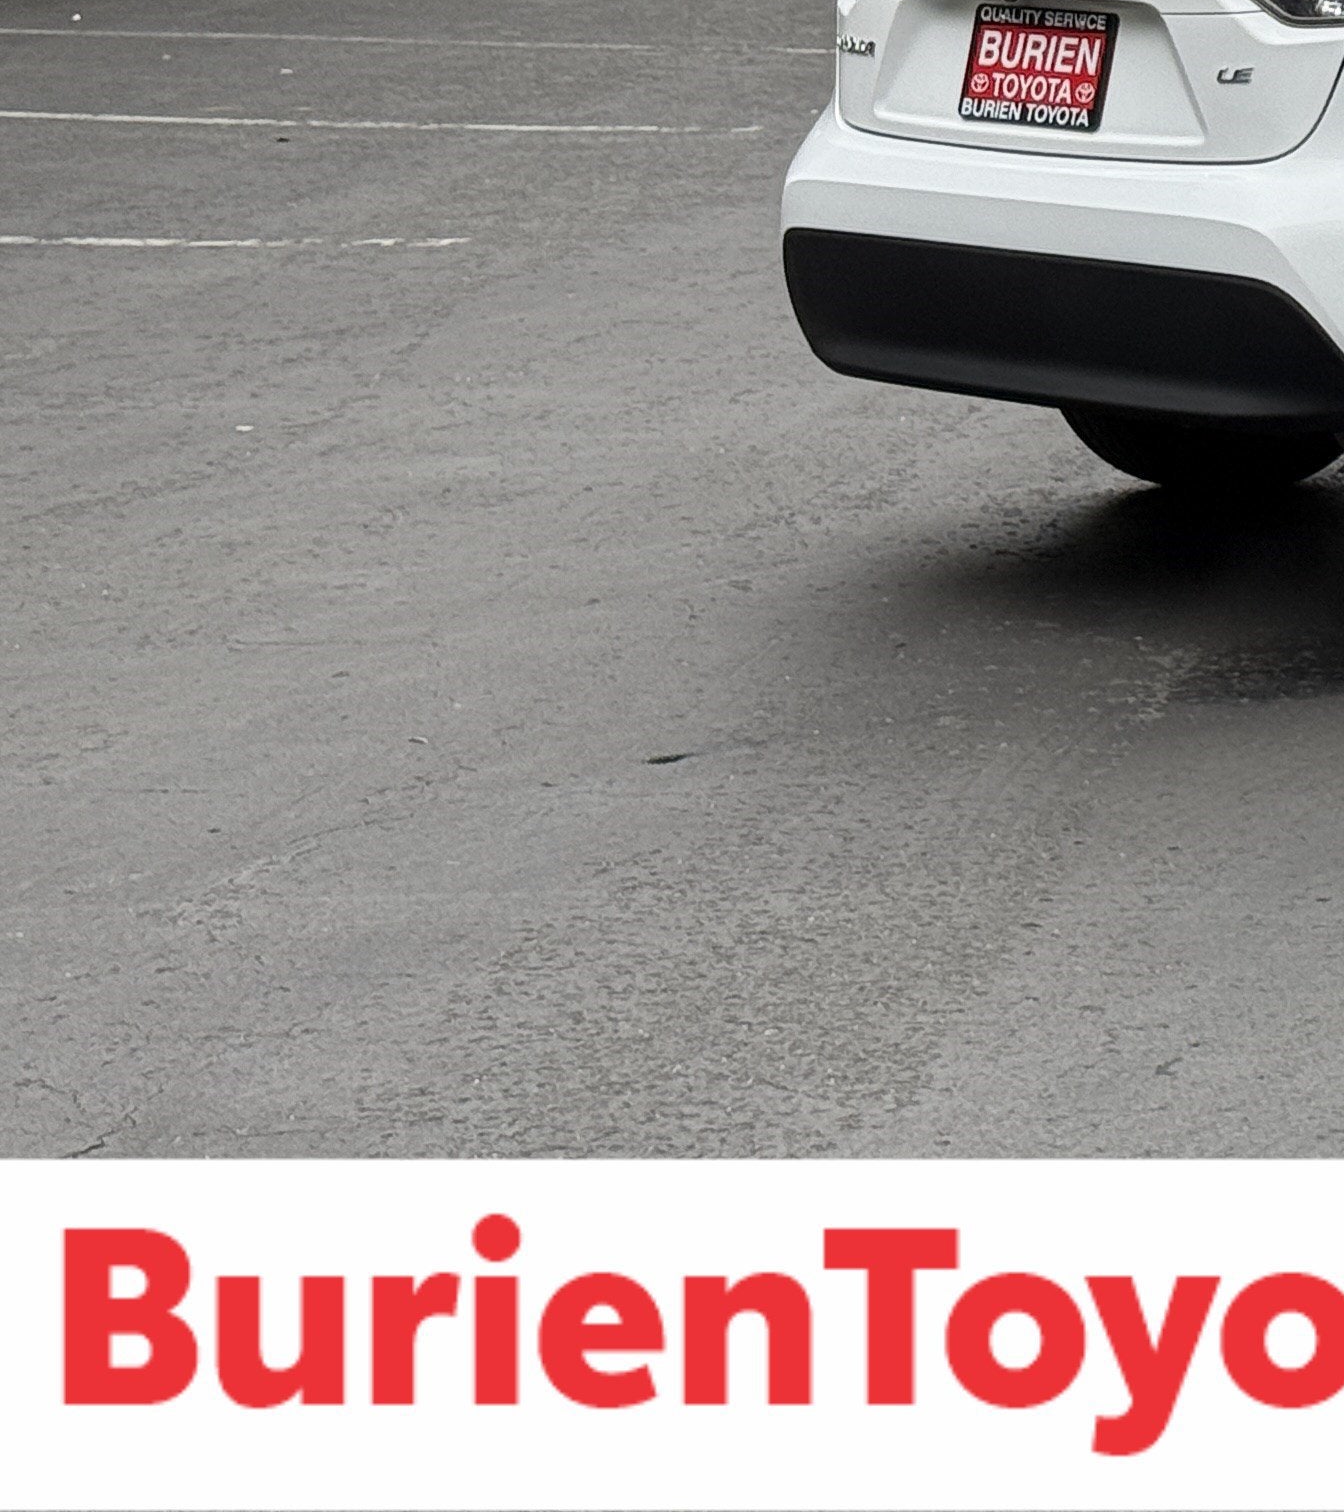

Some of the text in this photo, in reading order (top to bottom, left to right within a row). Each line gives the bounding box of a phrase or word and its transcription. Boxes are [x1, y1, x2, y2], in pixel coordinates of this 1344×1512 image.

[980, 6, 1108, 31] QUALITY SERVICE
[978, 29, 1102, 76] BURIEN
[991, 72, 1073, 104] TOYOTA
[1216, 67, 1254, 85] LE
[960, 98, 1090, 128] BURIEN TOYOTA
